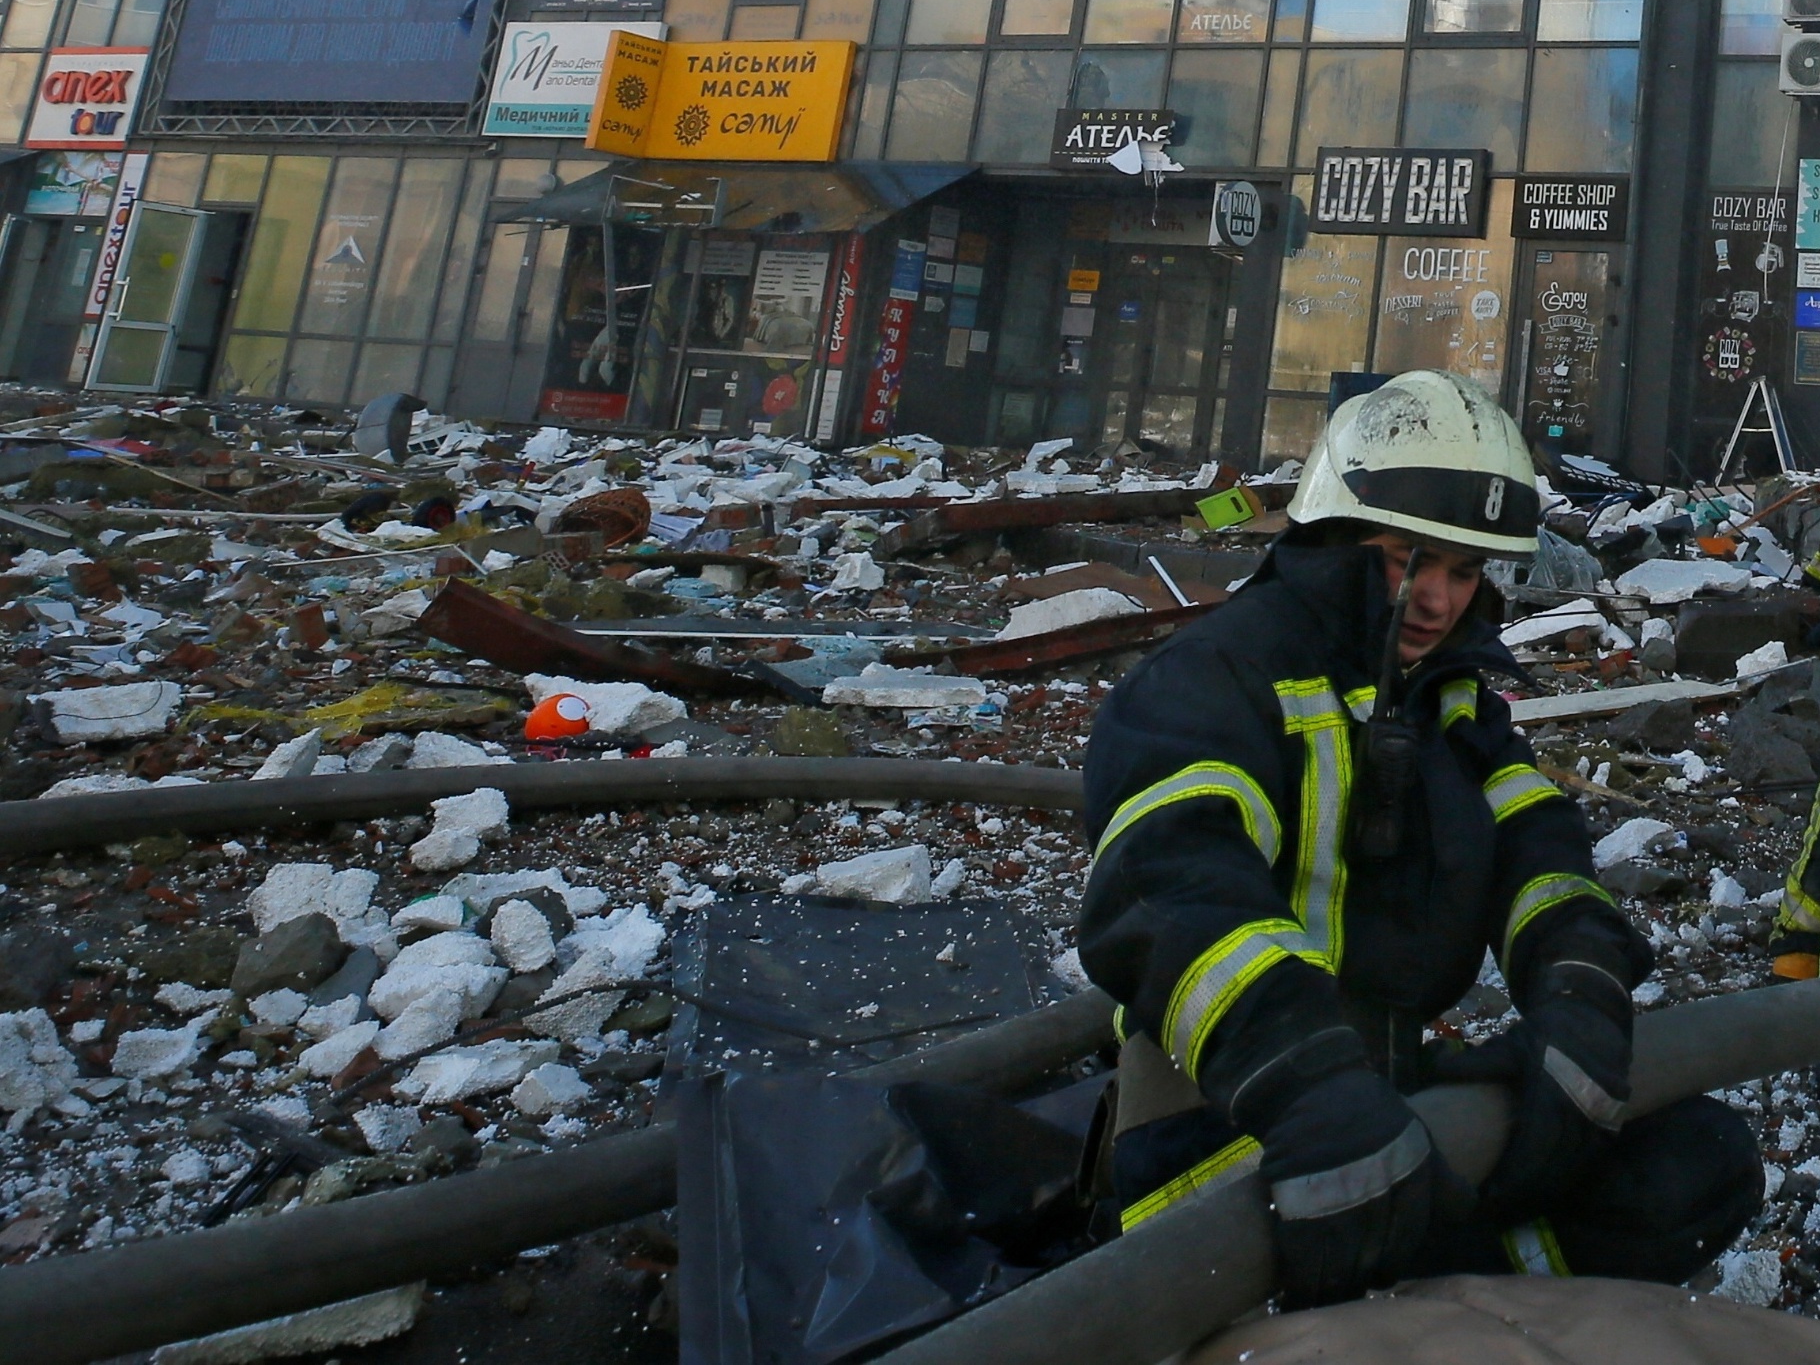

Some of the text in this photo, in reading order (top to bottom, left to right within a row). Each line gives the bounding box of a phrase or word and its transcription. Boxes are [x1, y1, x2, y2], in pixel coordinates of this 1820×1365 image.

[616, 49, 660, 67] МАСАЖ
[686, 51, 818, 74] ТАЙСЬКИЙ
[43, 69, 134, 104] anex
[565, 73, 597, 86] Dental
[700, 79, 792, 98] МАСАЖ
[70, 108, 124, 135] tour
[495, 106, 580, 124] Медичний
[1081, 112, 1158, 122] MASTER
[1317, 156, 1474, 225] COZY BAR
[1523, 183, 1616, 207] COFFEE SHOP
[1231, 190, 1257, 217] COZY
[1713, 196, 1786, 219] COZY BAR
[1529, 209, 1609, 232] & YUMMIES
[1711, 218, 1729, 231] True
[1730, 219, 1751, 231] Taste
[1752, 220, 1762, 231] Of
[1404, 247, 1490, 283] COFFEE
[1384, 294, 1423, 314] DESSERT
[1475, 298, 1496, 307] TAKE
[1569, 316, 1583, 328] BAR
[1719, 338, 1741, 355] COZY
[1536, 411, 1586, 428] friendly
[1485, 476, 1505, 521] 8
